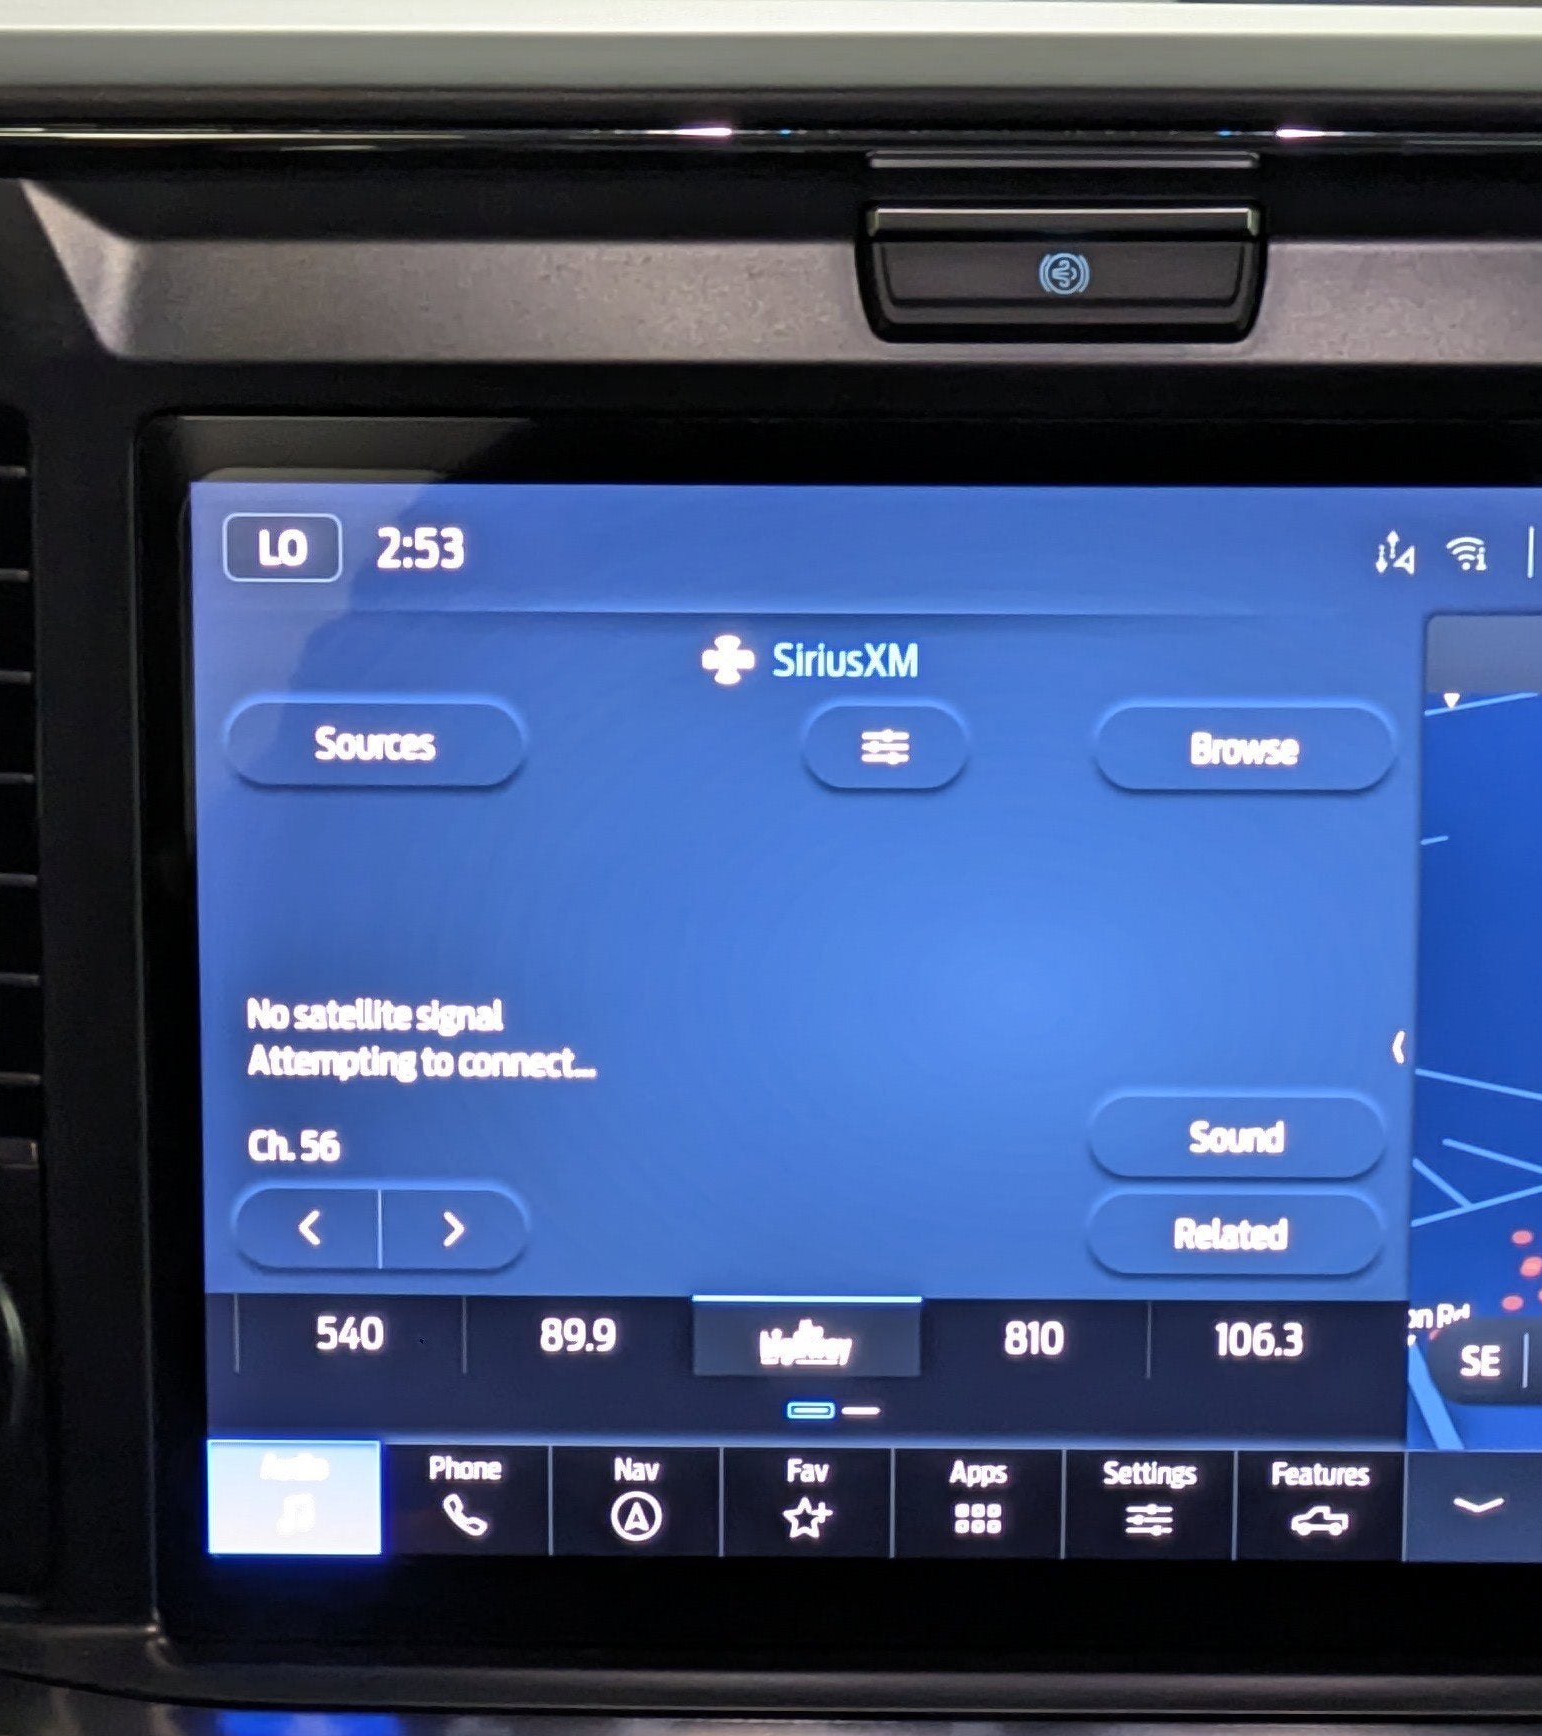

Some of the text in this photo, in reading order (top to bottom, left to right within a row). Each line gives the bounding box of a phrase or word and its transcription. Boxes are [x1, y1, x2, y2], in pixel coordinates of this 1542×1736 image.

[258, 526, 308, 568] LO
[377, 526, 465, 569] 2:53
[773, 642, 918, 678] SiriusXM
[314, 725, 437, 761] Sources
[1190, 731, 1300, 766] Browse
[247, 997, 505, 1037] No satellite signal
[247, 1043, 418, 1084] Attempting
[420, 1046, 455, 1078] to
[248, 1128, 341, 1162] Ch. 56
[1189, 1120, 1285, 1154] Sound
[1173, 1217, 1289, 1251] Related
[316, 1315, 385, 1351] 540
[540, 1317, 617, 1353] 89.9
[1004, 1320, 1065, 1356] 810
[1215, 1321, 1304, 1357] 106.3
[1460, 1344, 1501, 1377] SE
[429, 1455, 502, 1481] Phone
[614, 1457, 660, 1482] Nav
[787, 1458, 830, 1483] Fav
[949, 1459, 1008, 1488] Apps
[1103, 1460, 1198, 1490] Settings
[1271, 1461, 1371, 1487] Features
